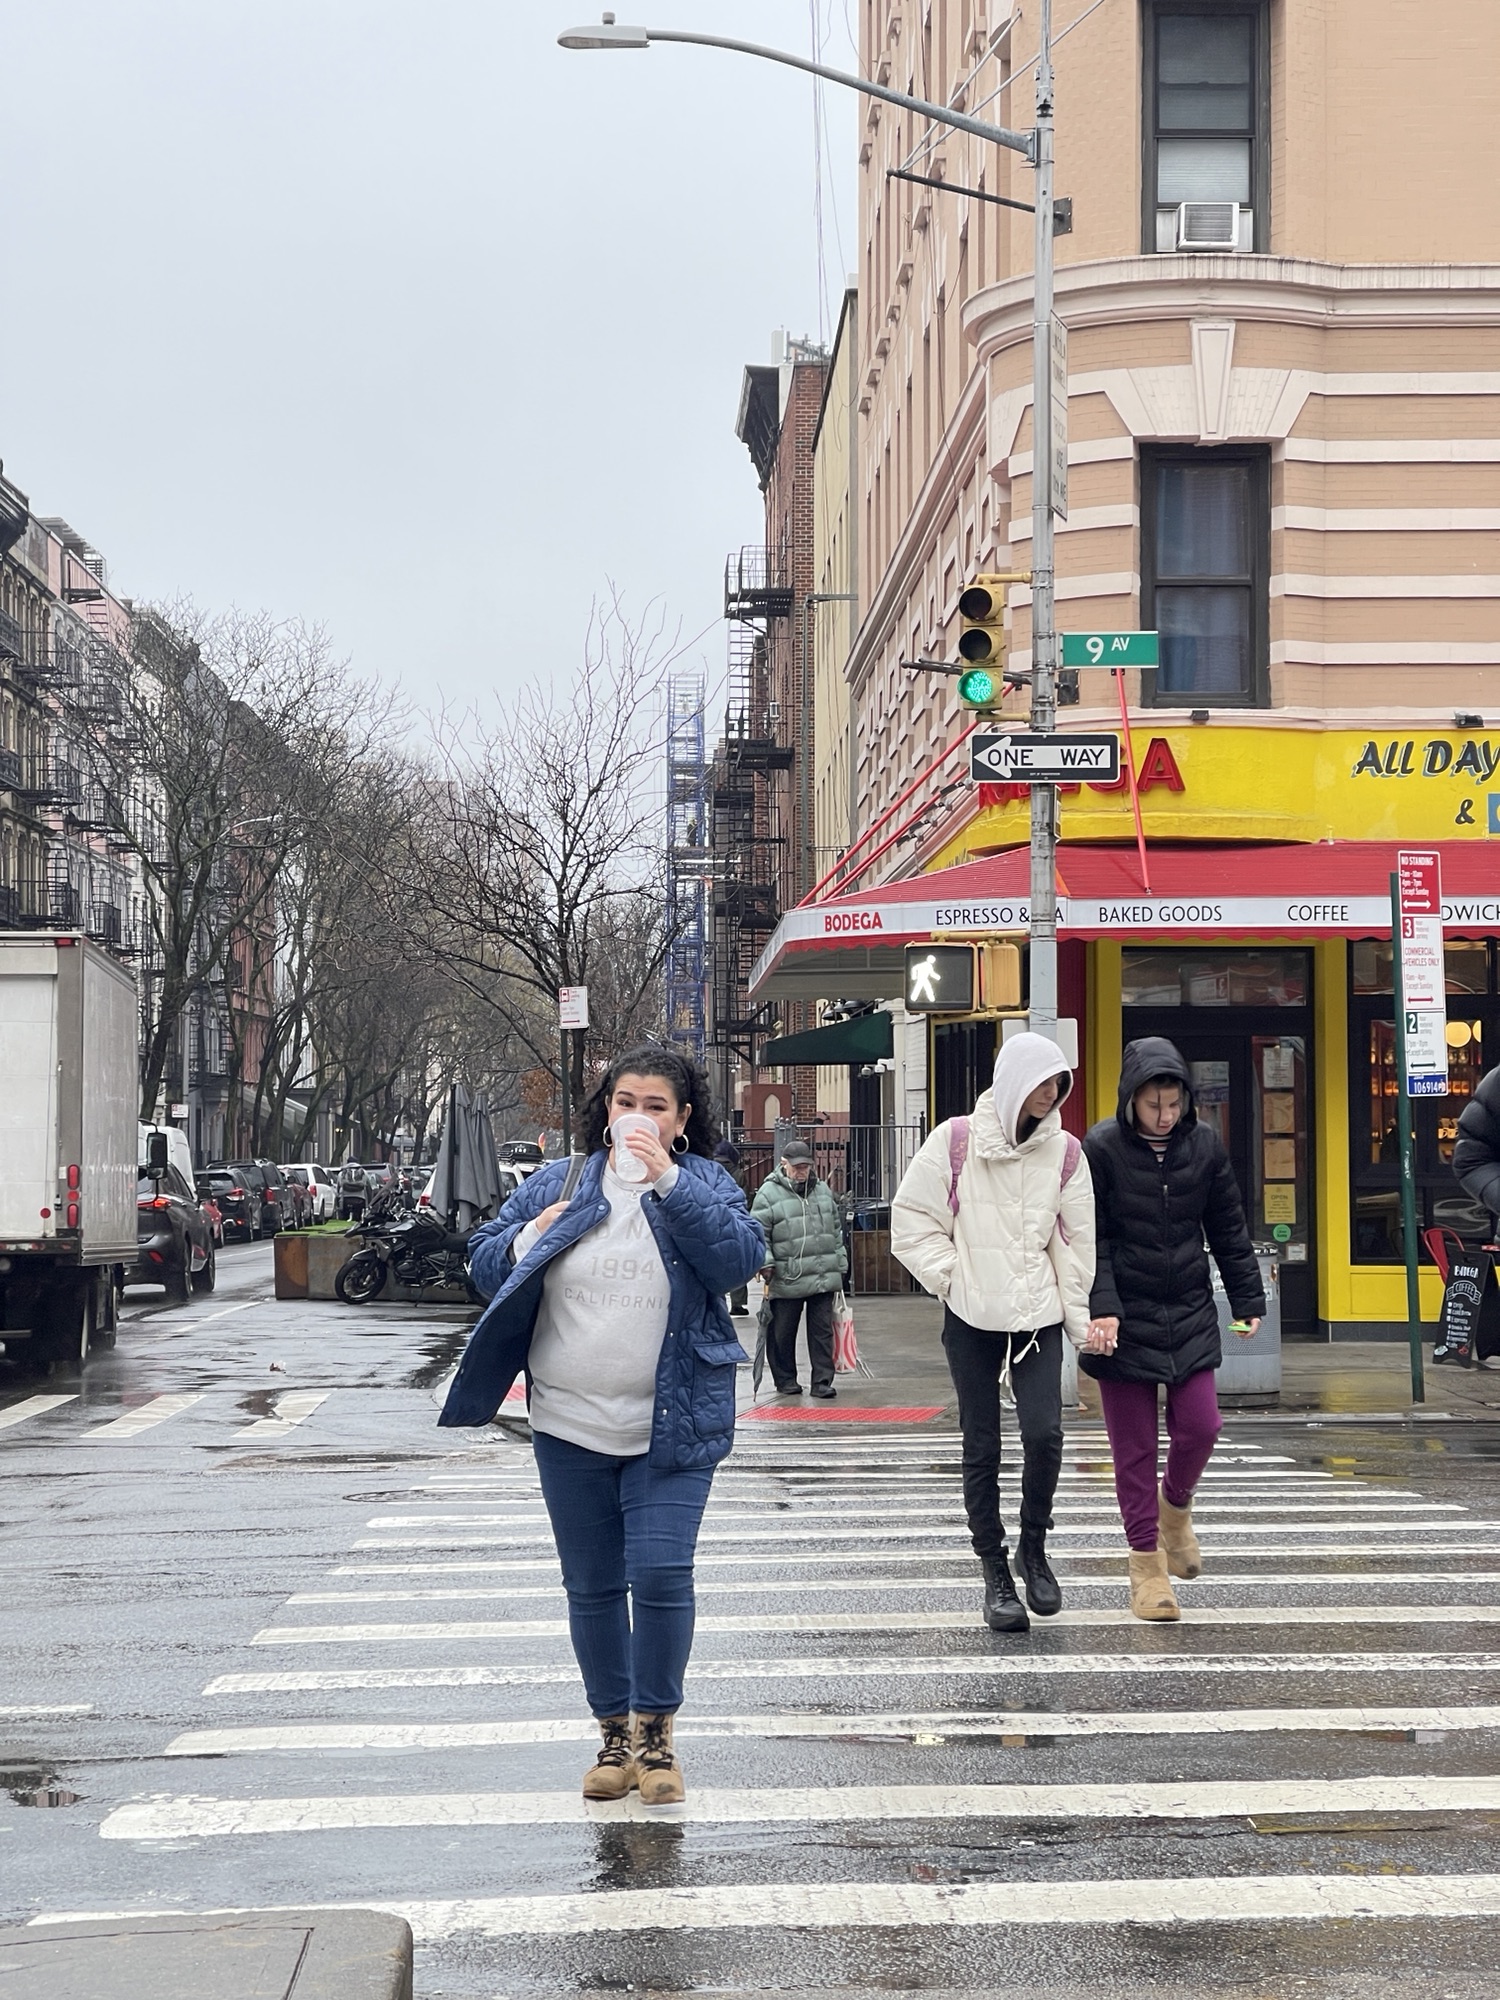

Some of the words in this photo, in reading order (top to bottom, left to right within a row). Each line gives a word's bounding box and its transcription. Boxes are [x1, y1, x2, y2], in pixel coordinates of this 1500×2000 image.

[1086, 637, 1104, 663] 9
[1111, 637, 1130, 651] AV
[987, 749, 1033, 766] ONE
[1060, 748, 1105, 766] WAY
[1351, 741, 1415, 778] ALL
[1422, 740, 1500, 785] DAY
[1455, 798, 1476, 825] &
[1401, 856, 1409, 866] NO
[1409, 856, 1434, 866] STANDING
[824, 911, 883, 932] BODEGA
[936, 907, 1013, 926] ESPRESSO
[1019, 907, 1030, 923] &
[1100, 906, 1153, 922] BAKED
[1158, 905, 1222, 922] GOODS
[1287, 905, 1349, 922] COFFEE
[1441, 904, 1500, 921] DWIC
[1404, 918, 1412, 937] 3
[1404, 947, 1435, 956] COMMERCIAL
[1405, 958, 1427, 967] VEHICLES
[1427, 958, 1440, 966] ONLY
[1408, 1013, 1417, 1033] 2
[1413, 1081, 1438, 1094] 106914
[591, 1256, 656, 1280] 1994
[563, 1287, 670, 1310] CALIFORNI
[1455, 1283, 1475, 1296] COFFEE
